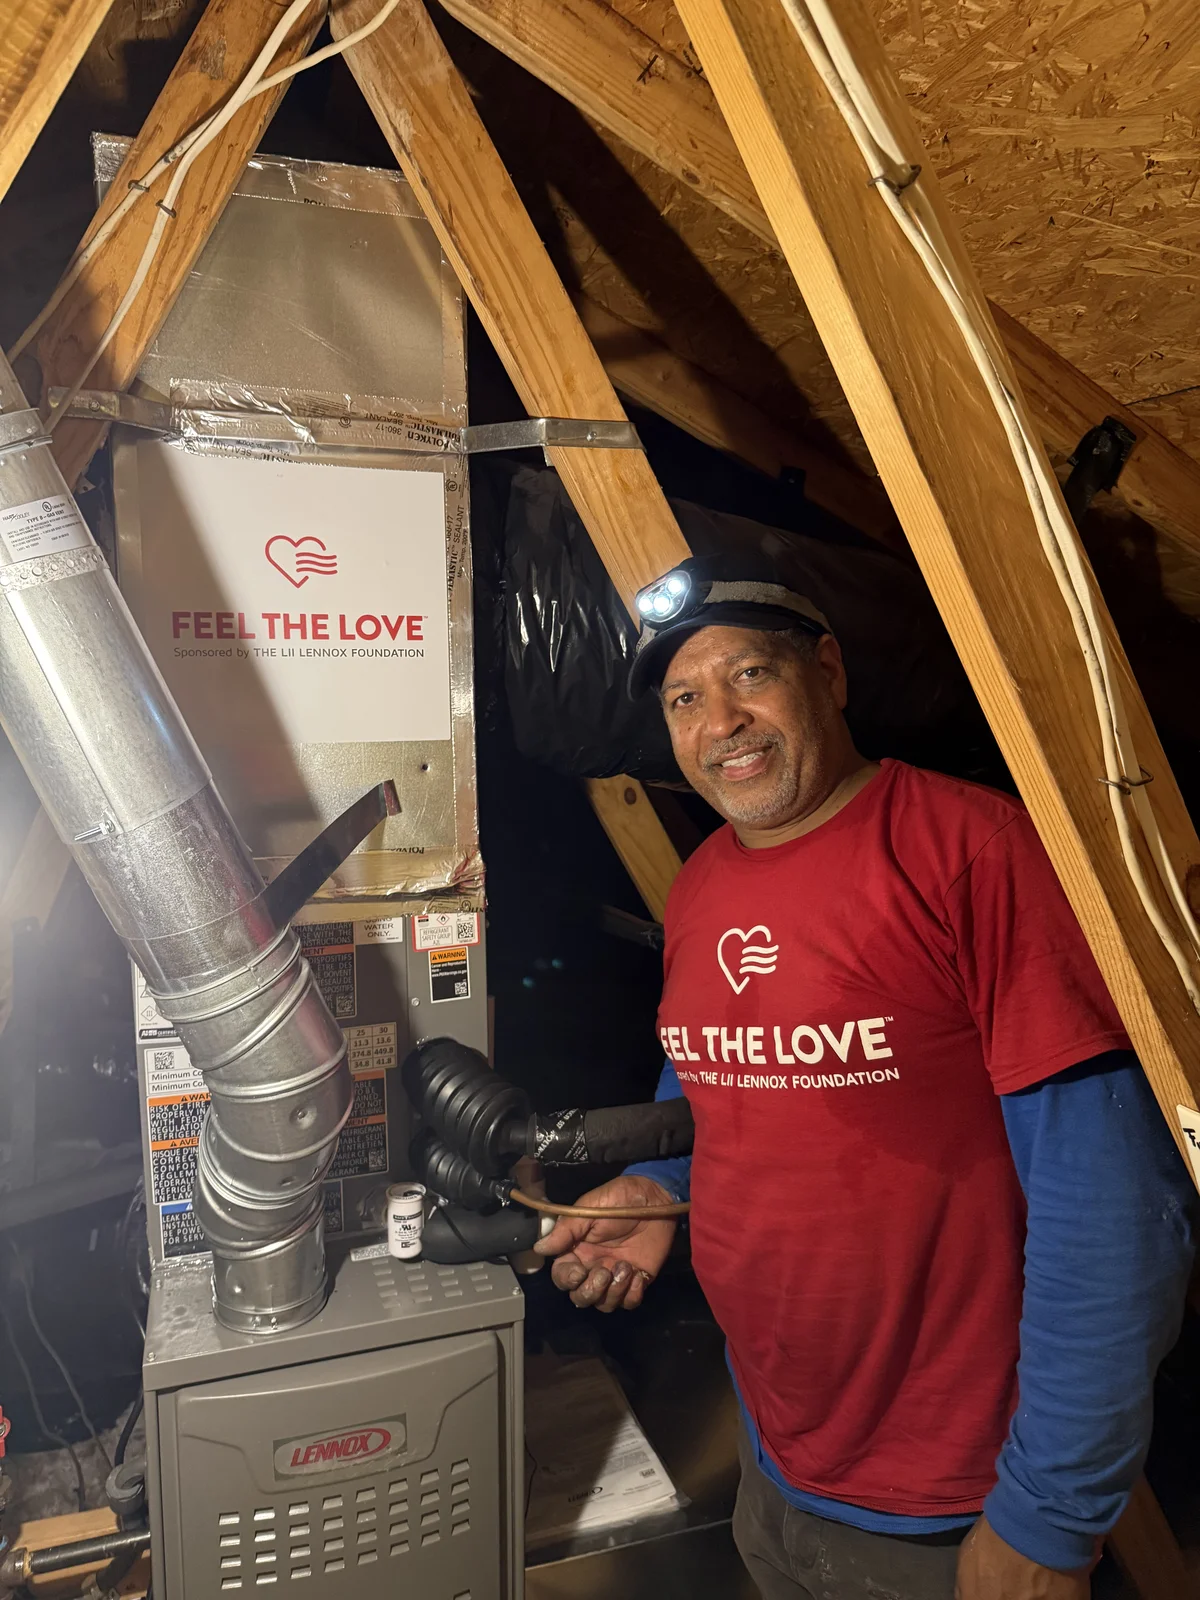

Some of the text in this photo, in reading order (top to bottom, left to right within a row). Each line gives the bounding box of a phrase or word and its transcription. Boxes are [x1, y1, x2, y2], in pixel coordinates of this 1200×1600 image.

[375, 422, 402, 436] 360-17
[453, 504, 464, 544] SEALANT
[172, 611, 256, 639] FEEL
[262, 612, 329, 640] THE
[173, 647, 233, 659] Sponsored
[237, 647, 249, 659] by
[253, 648, 276, 657] THE
[299, 648, 347, 657] LENNOX
[351, 648, 424, 658] FOUNDATION
[314, 930, 334, 939] WITH
[339, 928, 352, 937] THE
[367, 930, 391, 938] ONLY.
[438, 950, 465, 960] WARNING
[323, 984, 353, 994] SPOSITIFS
[376, 1035, 392, 1045] 13.6
[660, 1026, 701, 1061] EEL
[702, 1026, 767, 1065] THE
[151, 1071, 191, 1081] Minimum
[699, 1071, 718, 1085] THE
[737, 1074, 789, 1089] LENNOX
[792, 1067, 901, 1089] FOUNDATION
[151, 1083, 191, 1092] Minimum
[355, 1092, 379, 1102] AINED
[149, 1104, 169, 1114] RISK
[172, 1103, 183, 1111] OF
[355, 1098, 382, 1110] DO NOT
[150, 1108, 194, 1120] PROPERLY
[150, 1114, 203, 1128] WITH FEDE
[151, 1122, 203, 1135] REGULATIO
[151, 1129, 201, 1142] REFRIGERA
[152, 1148, 181, 1159] RISQUE
[153, 1153, 199, 1166] CORRECT
[153, 1161, 196, 1174] CONFOR
[155, 1190, 193, 1203] INFLAM
[162, 1213, 180, 1223] LEAK
[163, 1225, 201, 1238] BE POWE
[163, 1232, 205, 1246] FOR SERV
[290, 1432, 373, 1468] LENNOX
